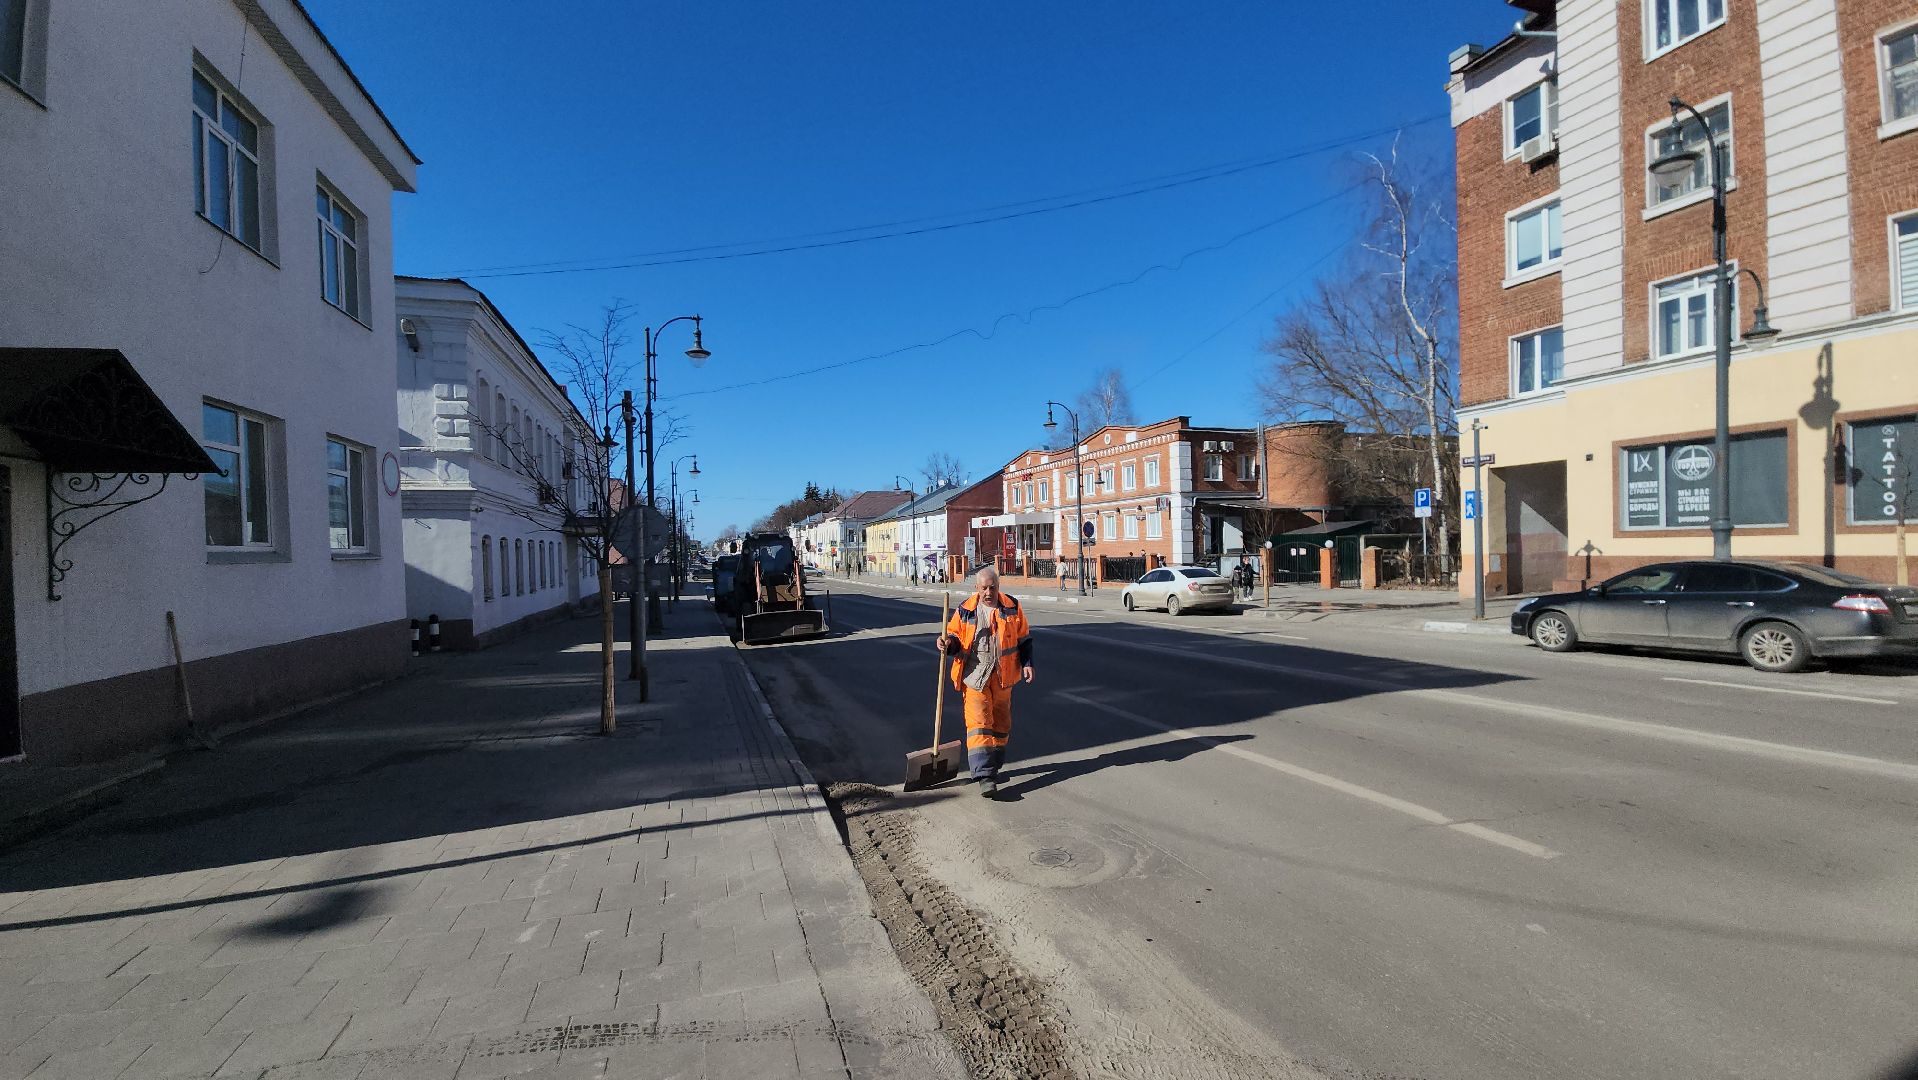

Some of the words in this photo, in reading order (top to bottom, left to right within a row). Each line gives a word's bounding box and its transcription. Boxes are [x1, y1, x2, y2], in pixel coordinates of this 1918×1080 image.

[1883, 438, 1896, 516] TATTOO
[1694, 488, 1709, 496] ВАС
[1417, 491, 1426, 506] P
[1629, 503, 1658, 511] БОРОДЫ
